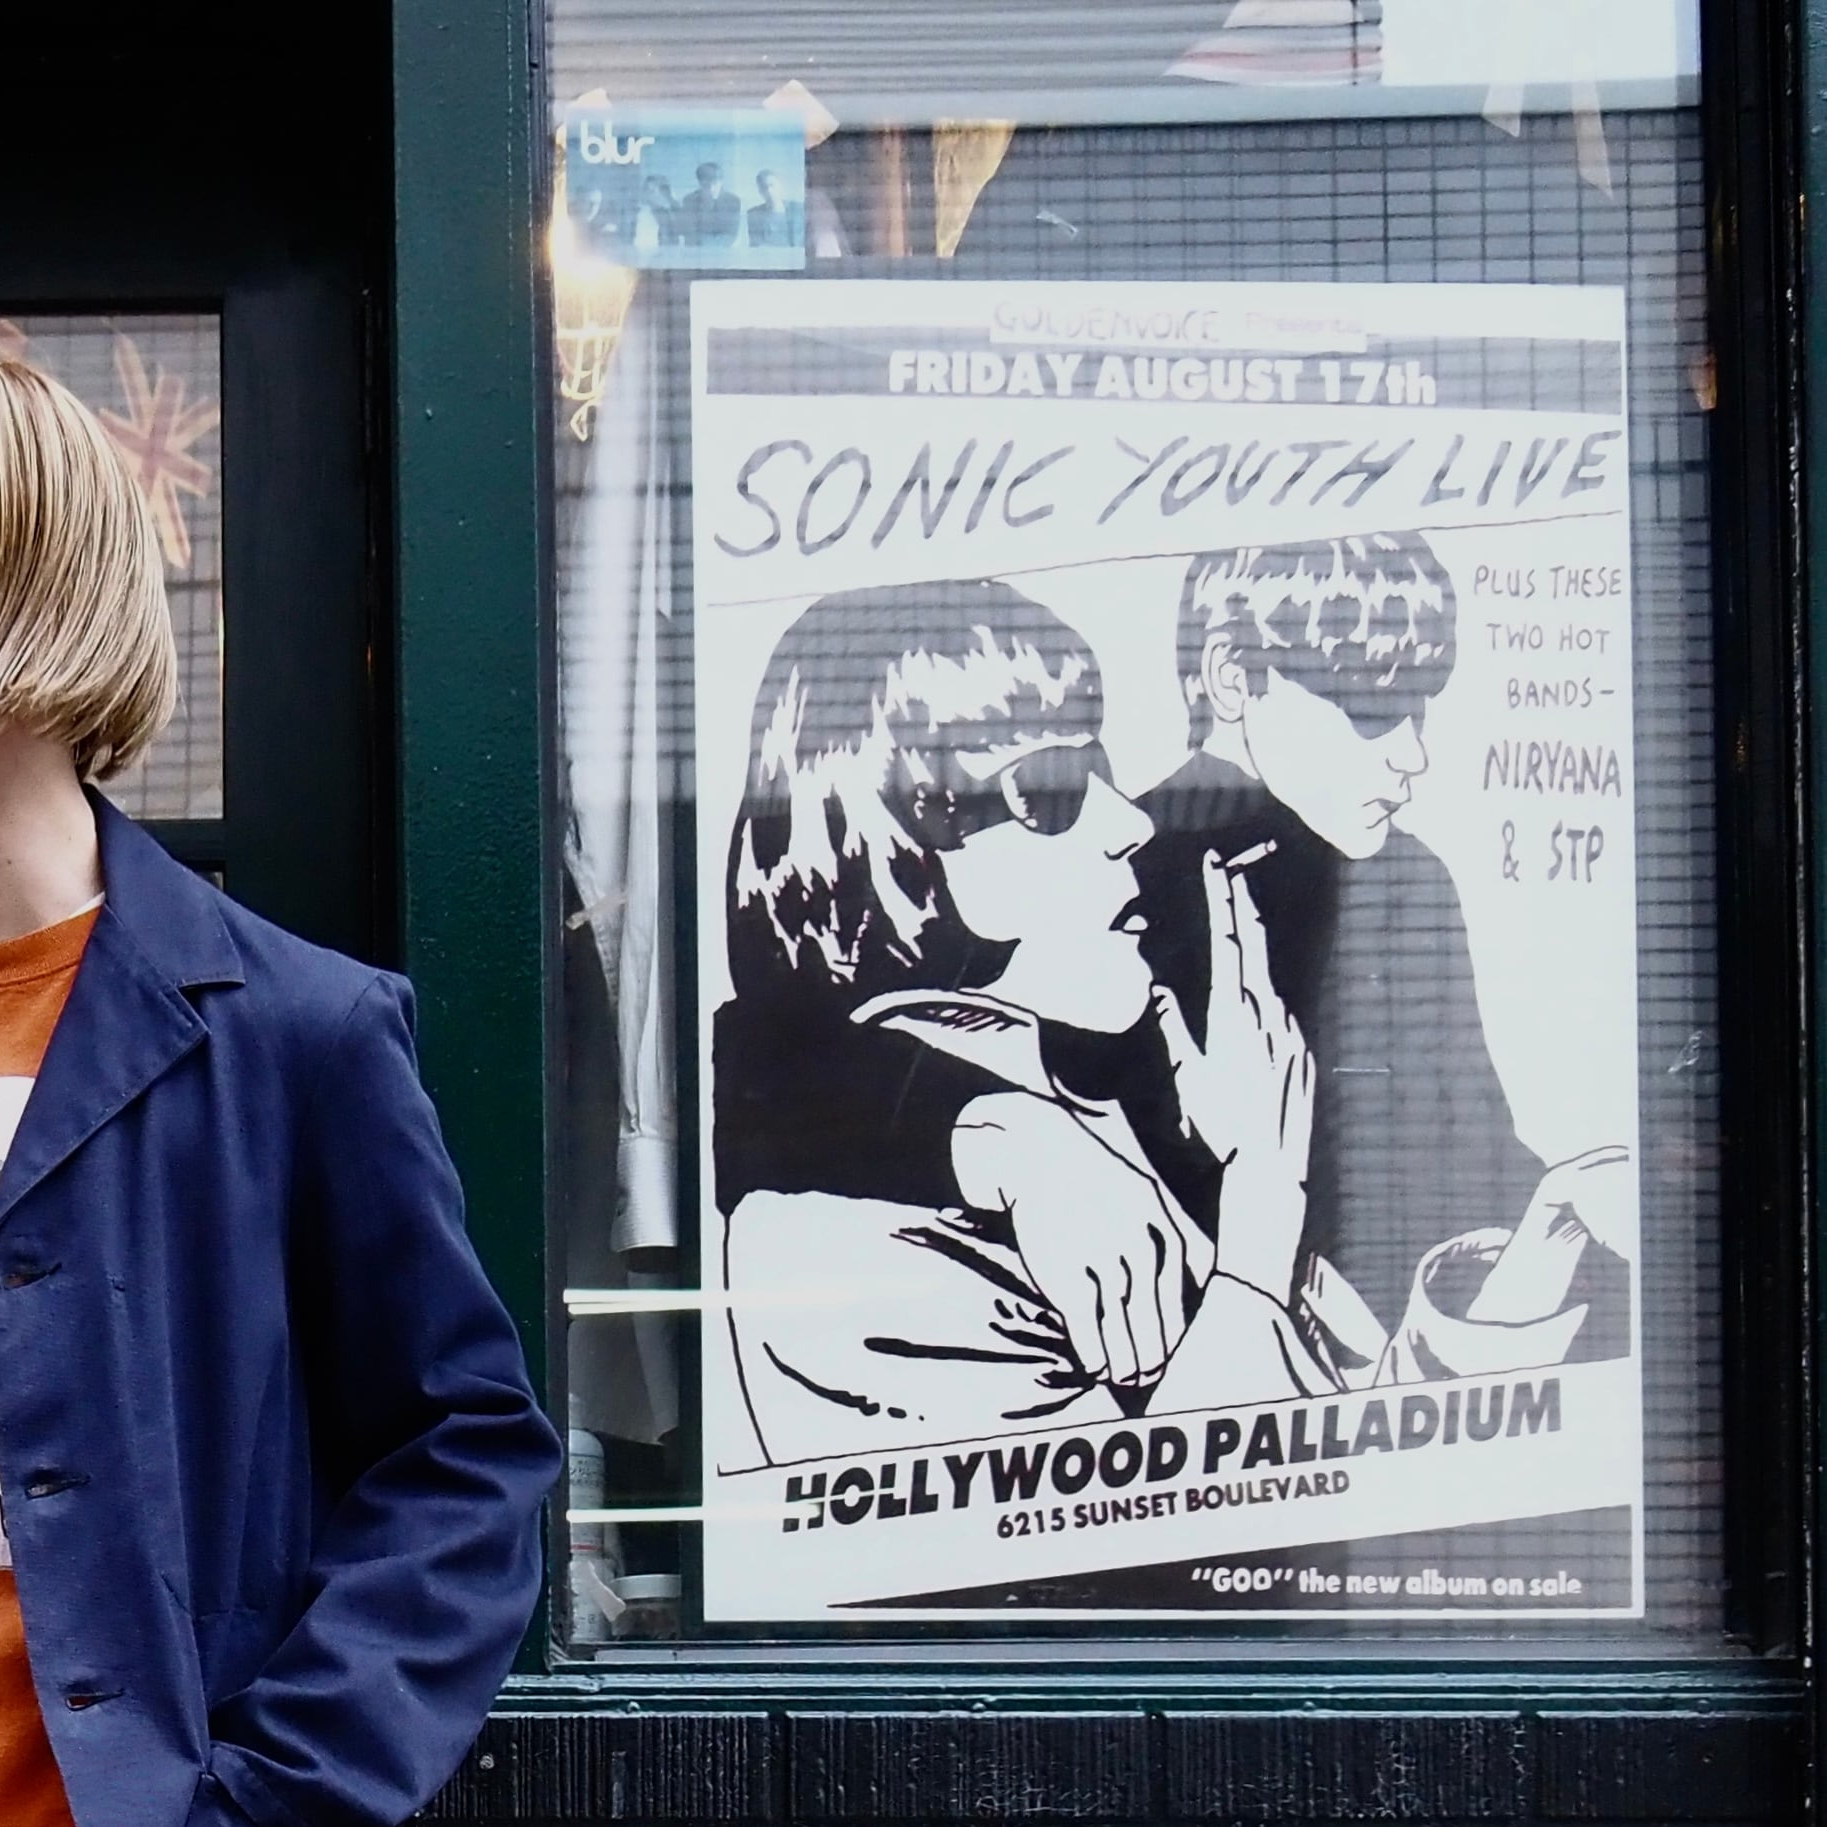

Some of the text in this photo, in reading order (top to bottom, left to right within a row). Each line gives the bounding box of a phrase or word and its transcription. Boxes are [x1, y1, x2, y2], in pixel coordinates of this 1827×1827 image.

[580, 120, 655, 165] blur
[887, 350, 1438, 406] FRIDAY AUGUST 17th
[713, 428, 1623, 558] SONIC YOUTH LIVE
[1472, 564, 1622, 600] PLUS THESE
[1485, 622, 1611, 654] TWO HOT
[1482, 739, 1623, 798] NIRVANA
[1501, 819, 1605, 884] & STP
[781, 1377, 1562, 1533] HOLLYWOOD PALLADIUM
[996, 1469, 1351, 1540] 6215 SUNSET BOULEVARD
[1298, 1567, 1341, 1593] the
[1345, 1574, 1401, 1594] new
[1405, 1568, 1487, 1596] album
[1490, 1575, 1525, 1596] on
[1528, 1571, 1583, 1596] sale
